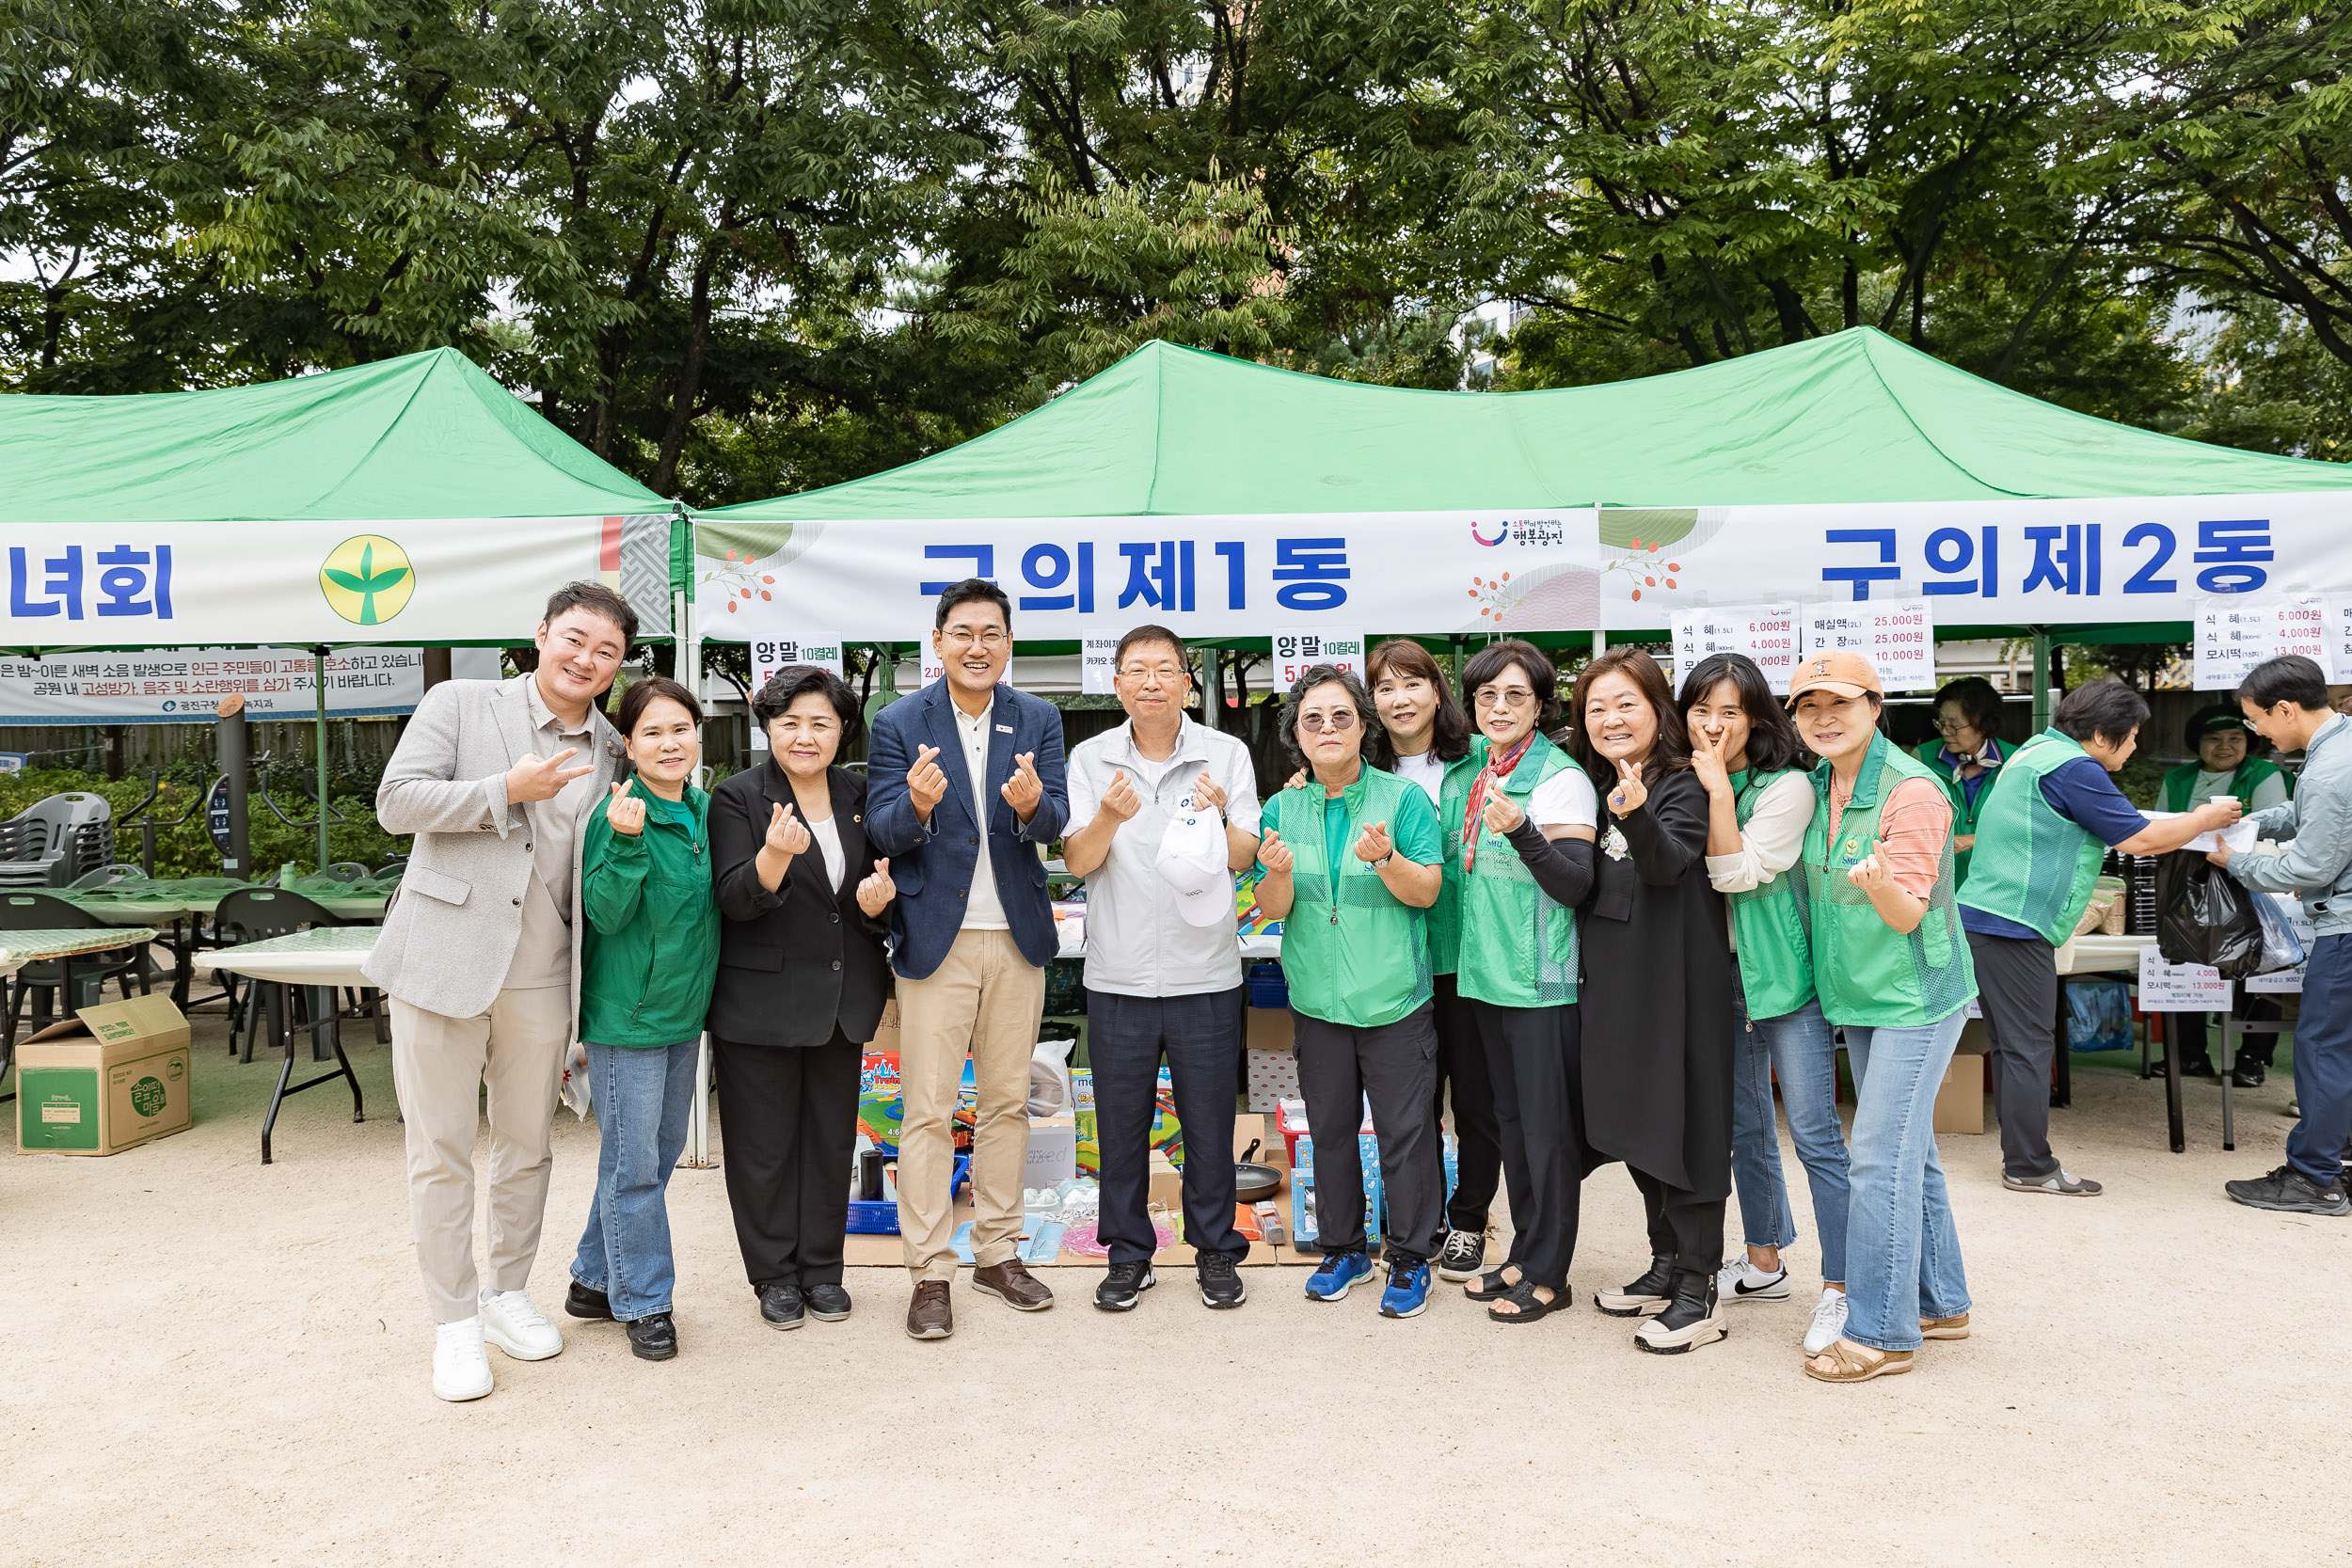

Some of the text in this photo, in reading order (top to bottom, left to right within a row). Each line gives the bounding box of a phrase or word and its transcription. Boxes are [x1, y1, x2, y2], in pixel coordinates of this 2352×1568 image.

[1513, 529, 1562, 546] 행복광진
[8, 545, 173, 620] 녀회
[1875, 614, 1923, 626] 25,000원
[2279, 610, 2322, 621] 6,000원
[1750, 621, 1790, 632] 6,000원
[2280, 626, 2321, 639] 4,000원
[1751, 638, 1791, 649] 4,000원
[1875, 632, 1923, 643] 25,000원
[801, 647, 838, 660] 10켤레
[1323, 641, 1360, 655] 10켤레
[2274, 645, 2322, 657] 13,000원
[1876, 649, 1924, 660] 10,000원
[72, 664, 99, 678] 새벽
[103, 664, 129, 678] 소음
[133, 663, 187, 677] 발생으로
[191, 662, 219, 675] 인근
[222, 660, 277, 674] 주민들이
[33, 682, 62, 696] 공원
[63, 682, 79, 696] 내
[81, 682, 139, 696] 고성방가,
[143, 680, 171, 695] 음주
[174, 679, 187, 694] 및
[191, 678, 260, 694] 소란행위를
[263, 677, 291, 692] 삼가
[338, 673, 395, 689] 바랍니다.
[180, 700, 219, 711] 광진구청
[1486, 839, 1502, 848] SMU
[874, 1075, 900, 1085] Train
